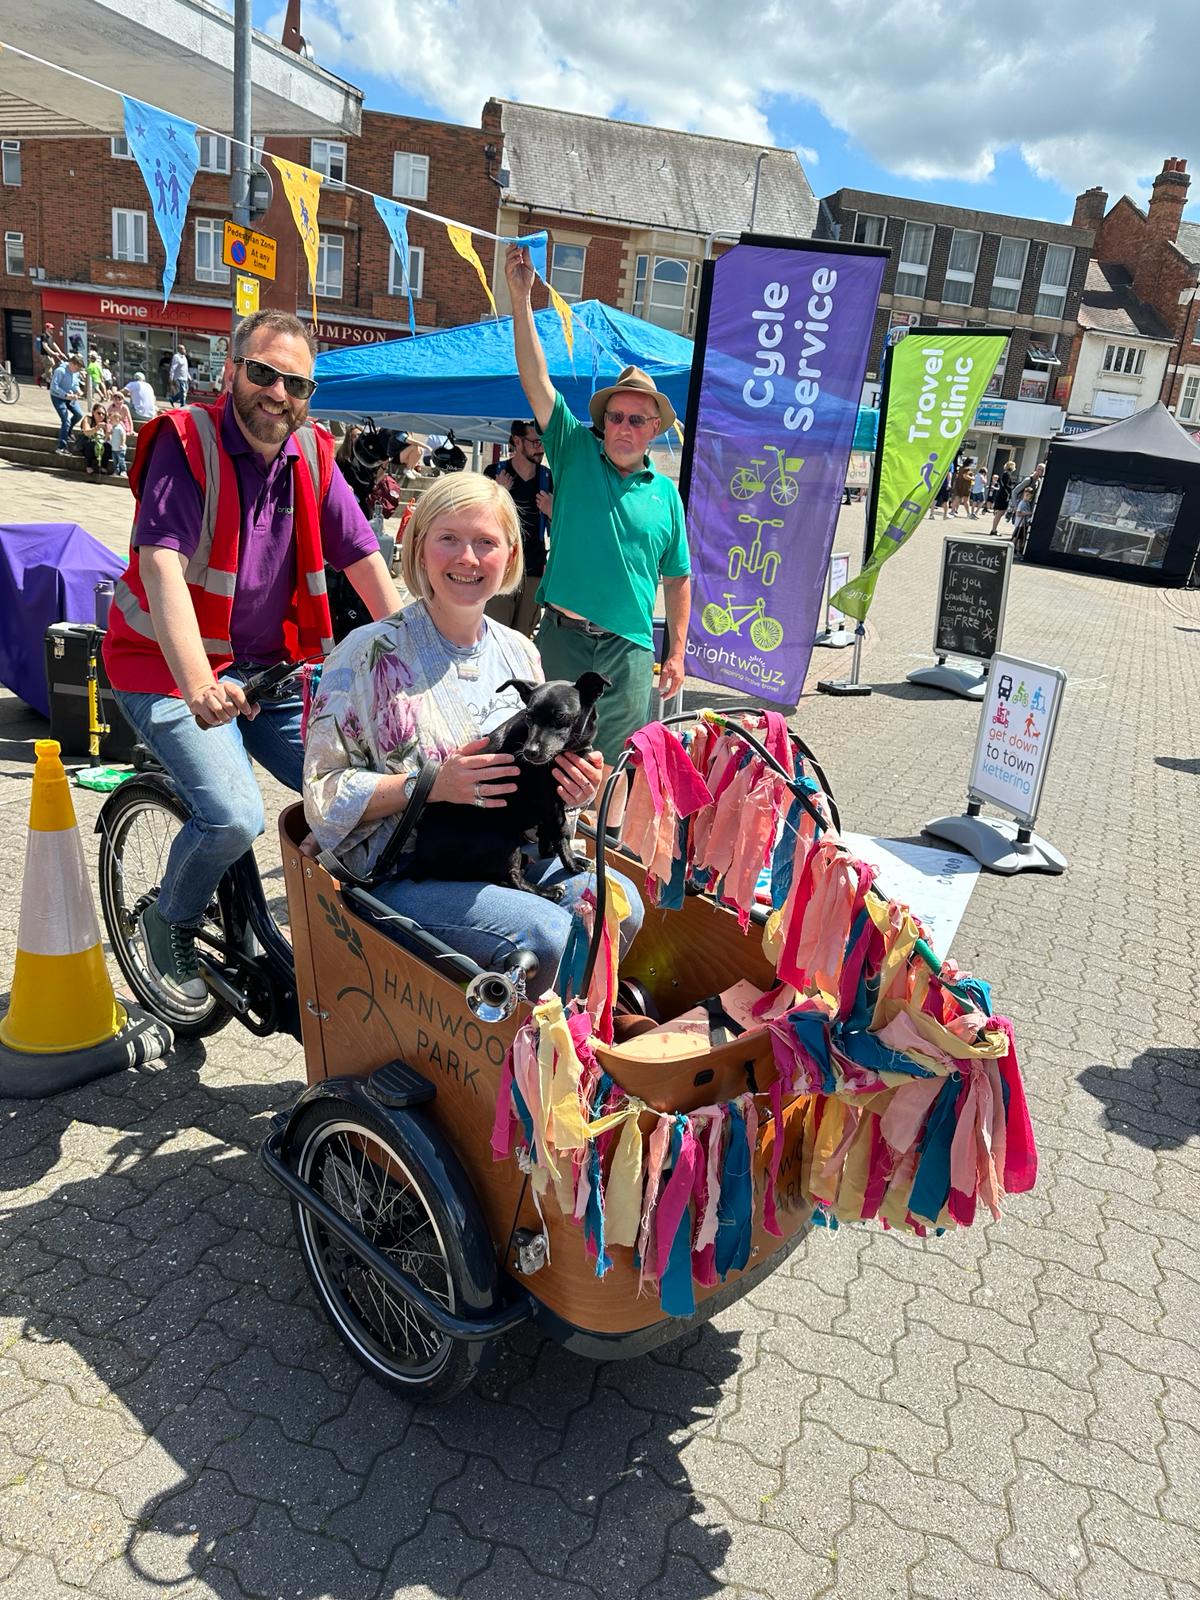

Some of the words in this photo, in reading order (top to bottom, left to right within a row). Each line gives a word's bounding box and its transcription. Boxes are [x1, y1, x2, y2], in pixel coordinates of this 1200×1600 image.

[250, 248, 258, 258] At
[259, 253, 270, 264] any
[260, 238, 275, 251] Zone
[253, 259, 267, 271] time
[100, 299, 148, 318] Phone
[307, 322, 388, 343] TIMPSON
[742, 282, 790, 408] Cycle
[783, 267, 838, 432] Service
[907, 348, 945, 443] Travel
[940, 356, 974, 439] Clinic
[947, 542, 974, 563] Free
[948, 569, 958, 587] If
[962, 576, 982, 591] you
[969, 605, 993, 622] CAR
[979, 596, 988, 607] to
[953, 614, 981, 630] FREE
[685, 638, 786, 686] brightwayz
[989, 727, 1007, 743] get
[1009, 734, 1039, 757] down
[986, 742, 1000, 761] to
[1003, 749, 1035, 776] town
[982, 760, 1031, 795] kettering
[383, 968, 506, 1066] HANWOO
[416, 1028, 481, 1096] PARK
